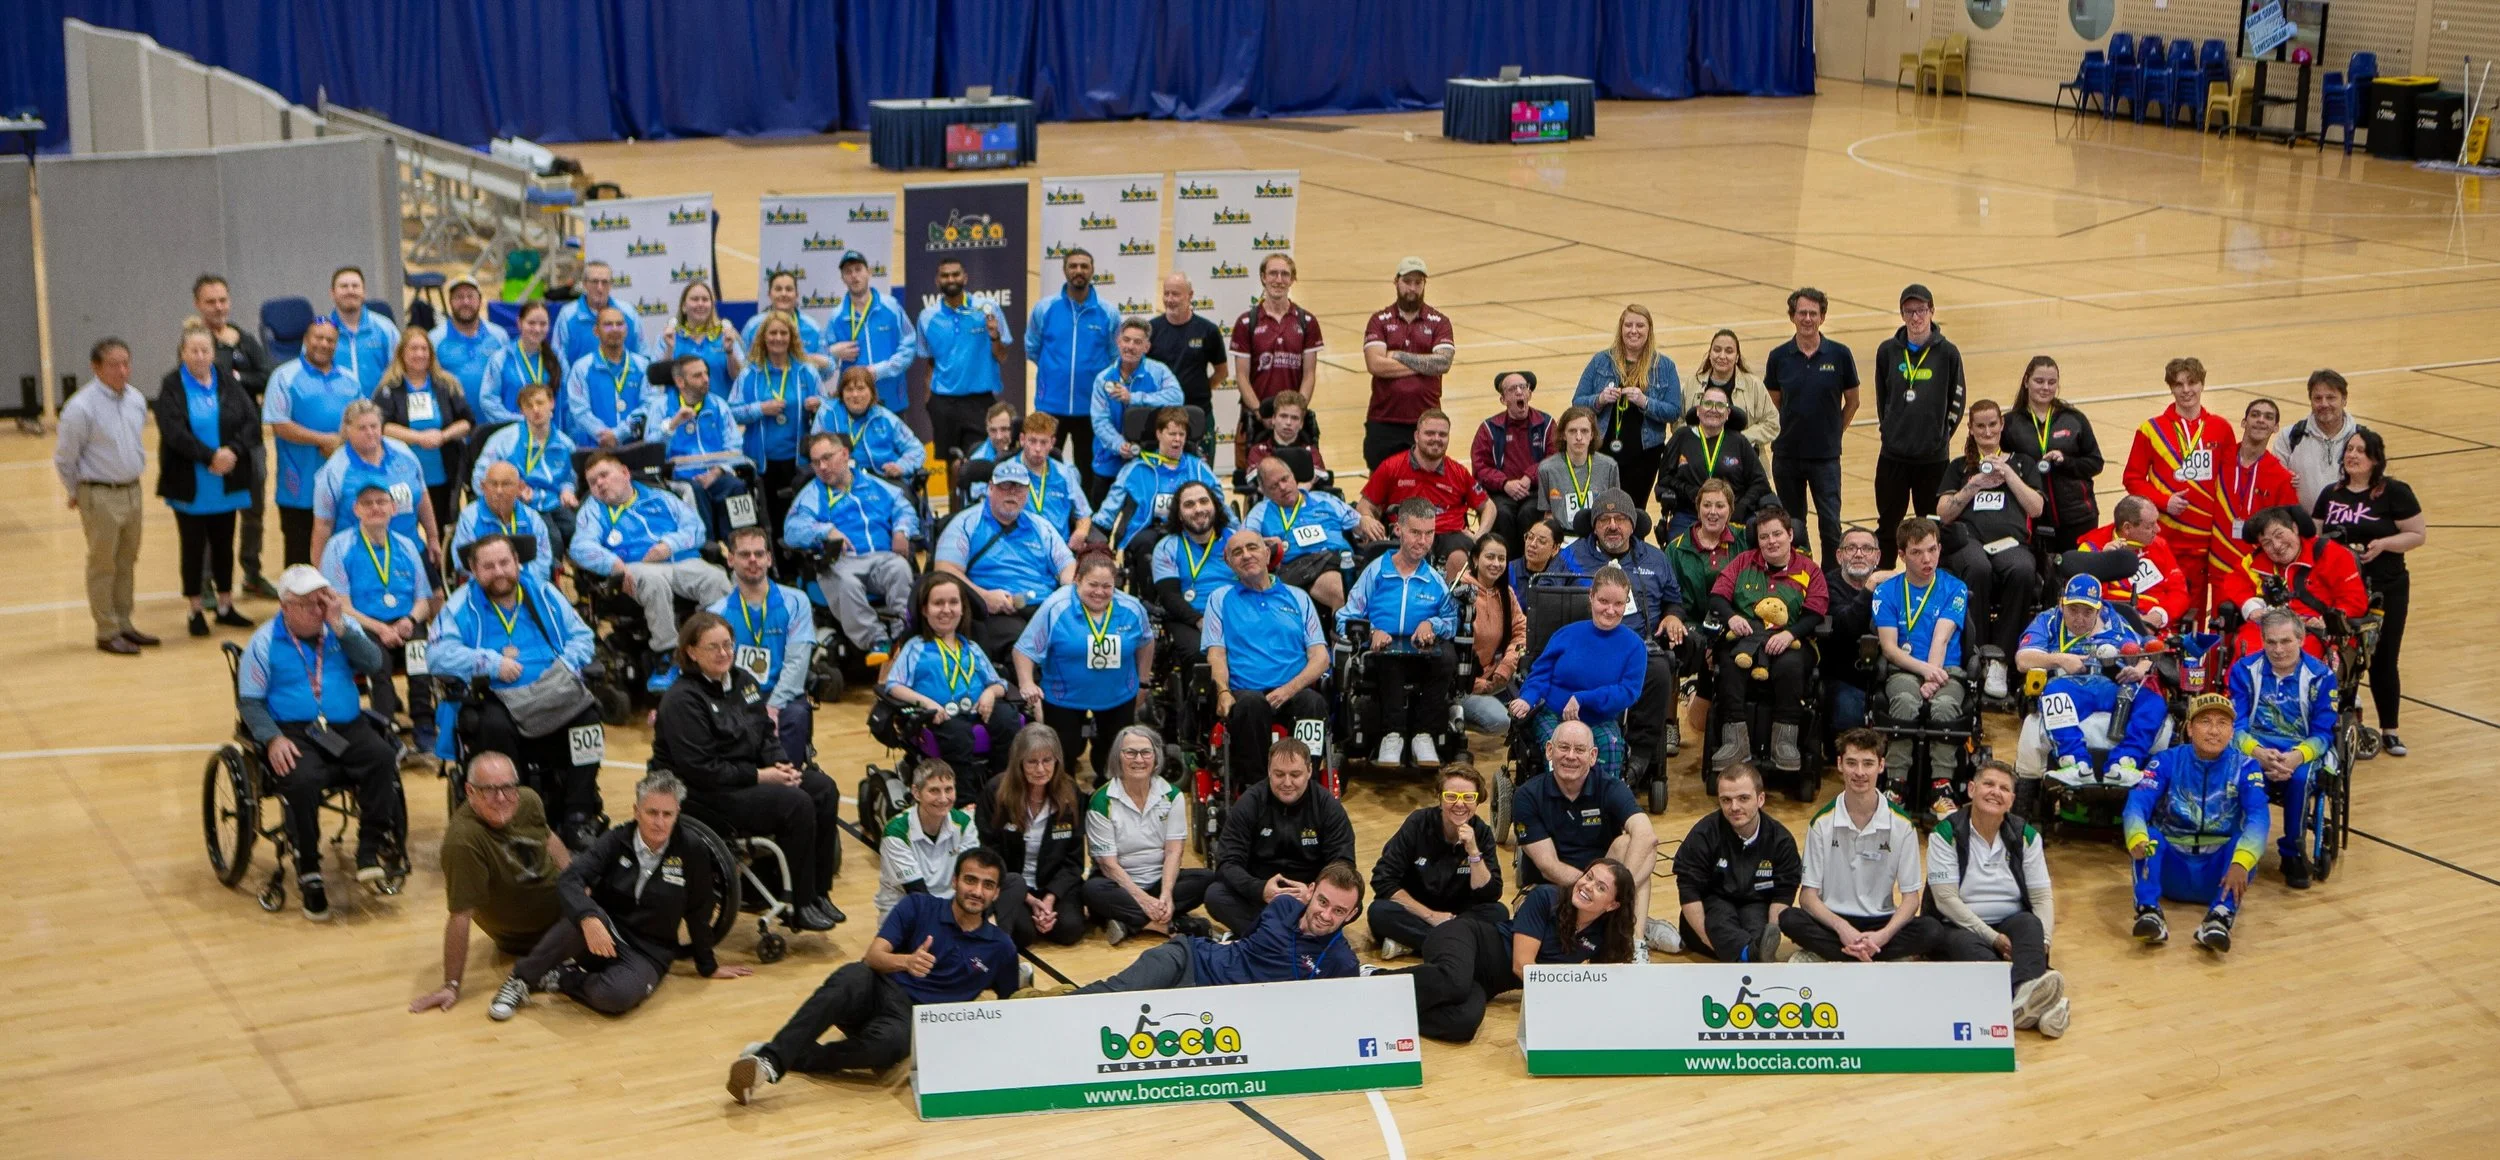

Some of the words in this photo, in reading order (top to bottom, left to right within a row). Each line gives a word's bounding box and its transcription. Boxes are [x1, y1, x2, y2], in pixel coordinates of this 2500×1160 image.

[928, 221, 1004, 242] boccia
[2185, 452, 2210, 469] 608
[1157, 495, 1172, 509] 30
[1976, 492, 2001, 503] 604
[732, 499, 750, 516] 310
[1298, 527, 1320, 541] 103
[1092, 637, 1117, 656] 601
[2045, 696, 2073, 716] 204
[572, 729, 602, 751] 502
[1296, 722, 1322, 742] 605
[1529, 970, 1608, 984] #bocciaAus
[920, 1007, 1002, 1024] #bocciaAus
[1702, 995, 1839, 1029] boccia
[1100, 1025, 1241, 1060] boccia
[1703, 1032, 1840, 1041] AUSTRALIA
[1102, 1055, 1244, 1073] AUSTRALIA
[1685, 1053, 1861, 1071] www.boccia.com.au
[1084, 1080, 1266, 1105] www.boccia.com.au
